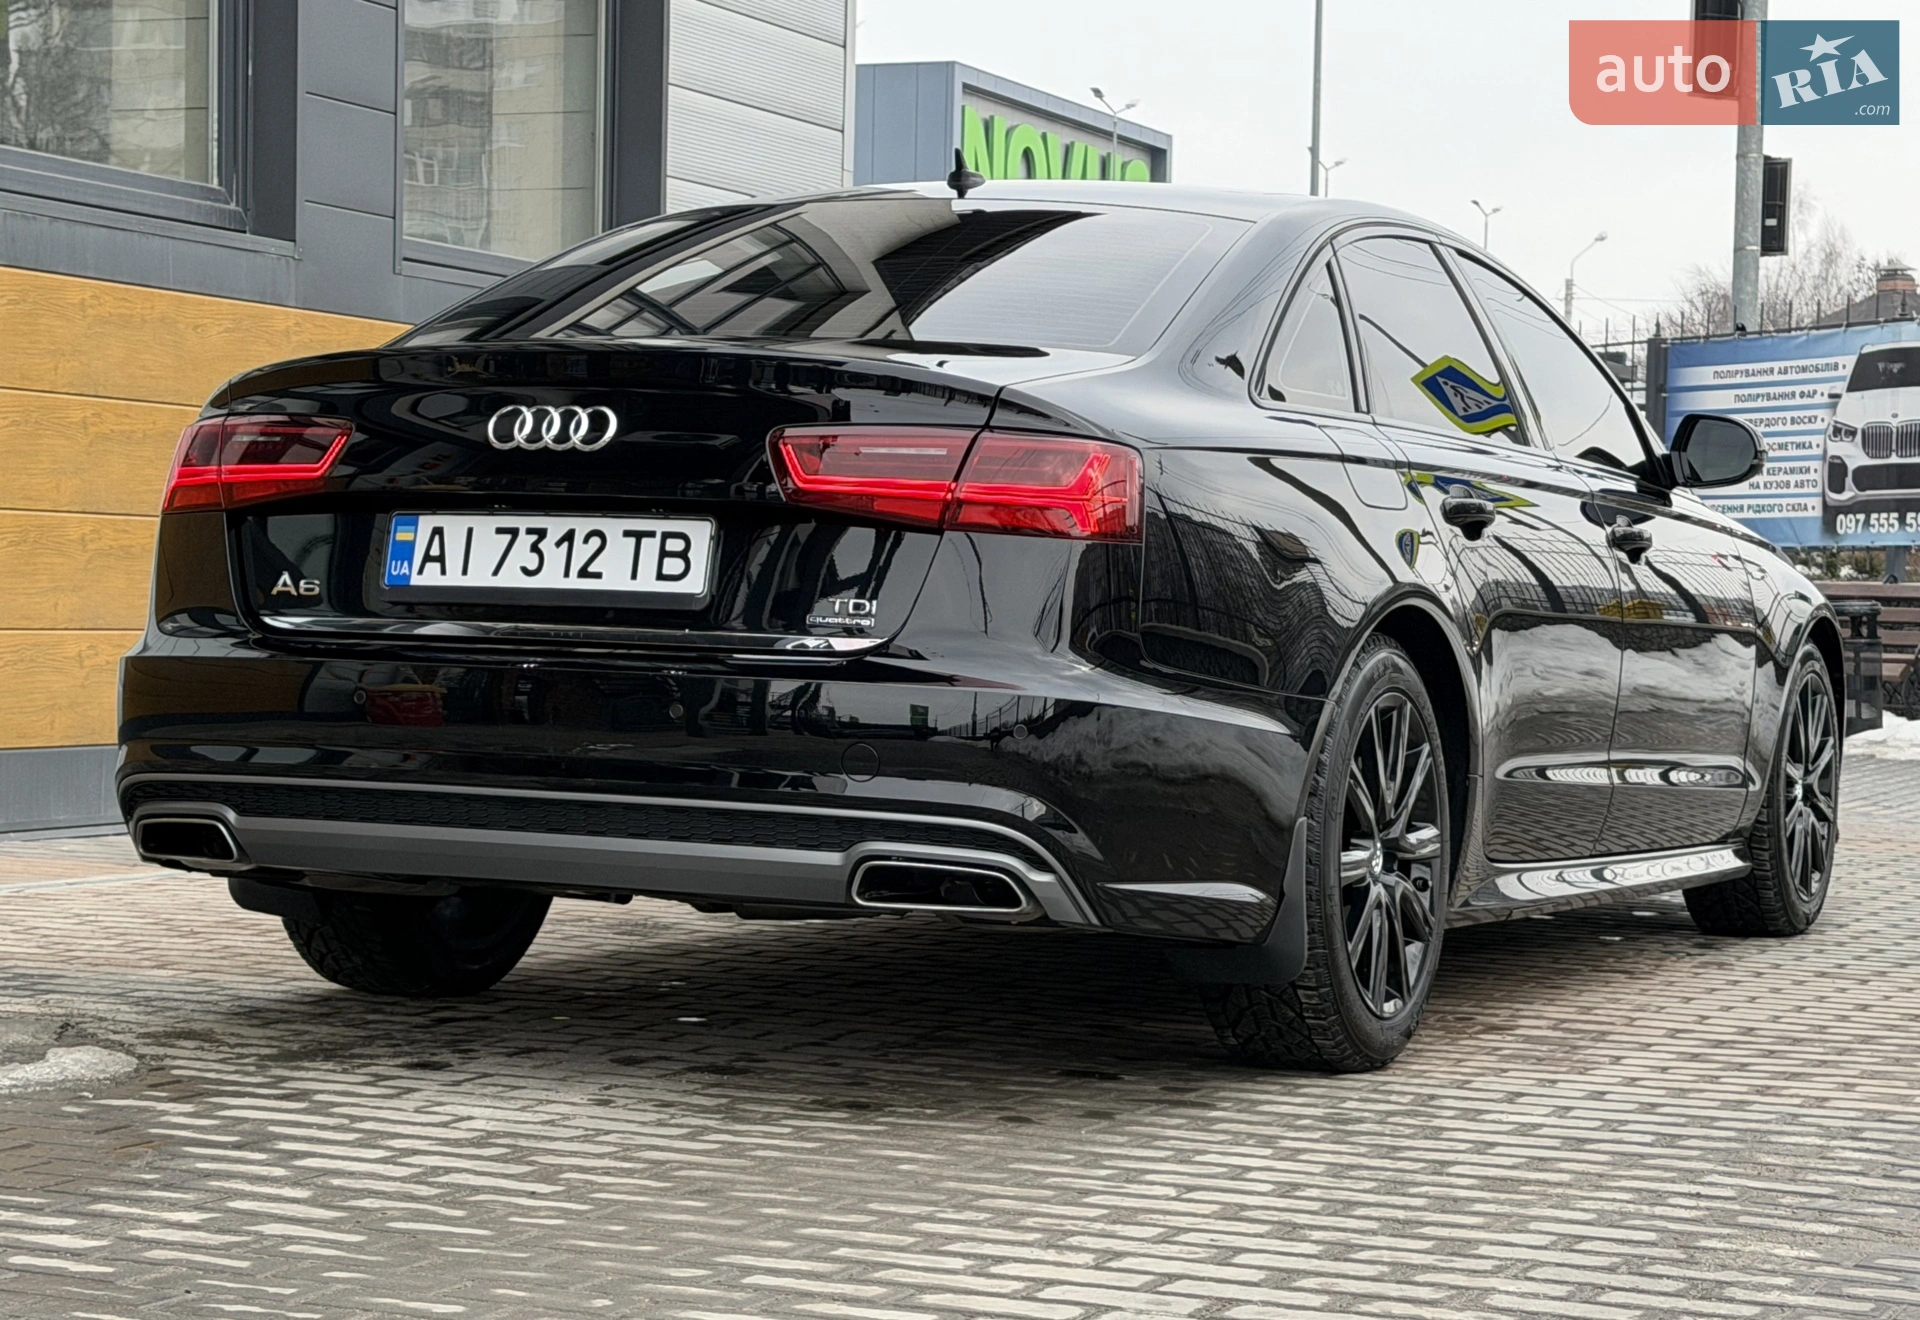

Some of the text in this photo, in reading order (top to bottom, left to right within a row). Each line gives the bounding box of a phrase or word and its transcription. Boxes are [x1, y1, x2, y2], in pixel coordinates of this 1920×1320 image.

[1712, 361, 1840, 380] ПОЛІРУВАННЯ АВТОМОБІЛІВ
[1733, 388, 1818, 404] ПОЛІРУВАННЯ ФАР
[1789, 414, 1818, 426] ВОСКУ
[1766, 465, 1811, 477] КЕРАМІКИ
[1748, 478, 1818, 490] НА КУЗОВ АВТО
[1746, 502, 1784, 515] РІДКОГО
[1785, 502, 1808, 513] СКЛА
[1836, 513, 1866, 535] 097
[1869, 512, 1899, 533] 555
[416, 526, 692, 582] AI 7312 TB
[391, 560, 410, 577] UA
[271, 570, 321, 596] A6
[828, 598, 877, 615] TDI
[809, 616, 871, 627] quattro
